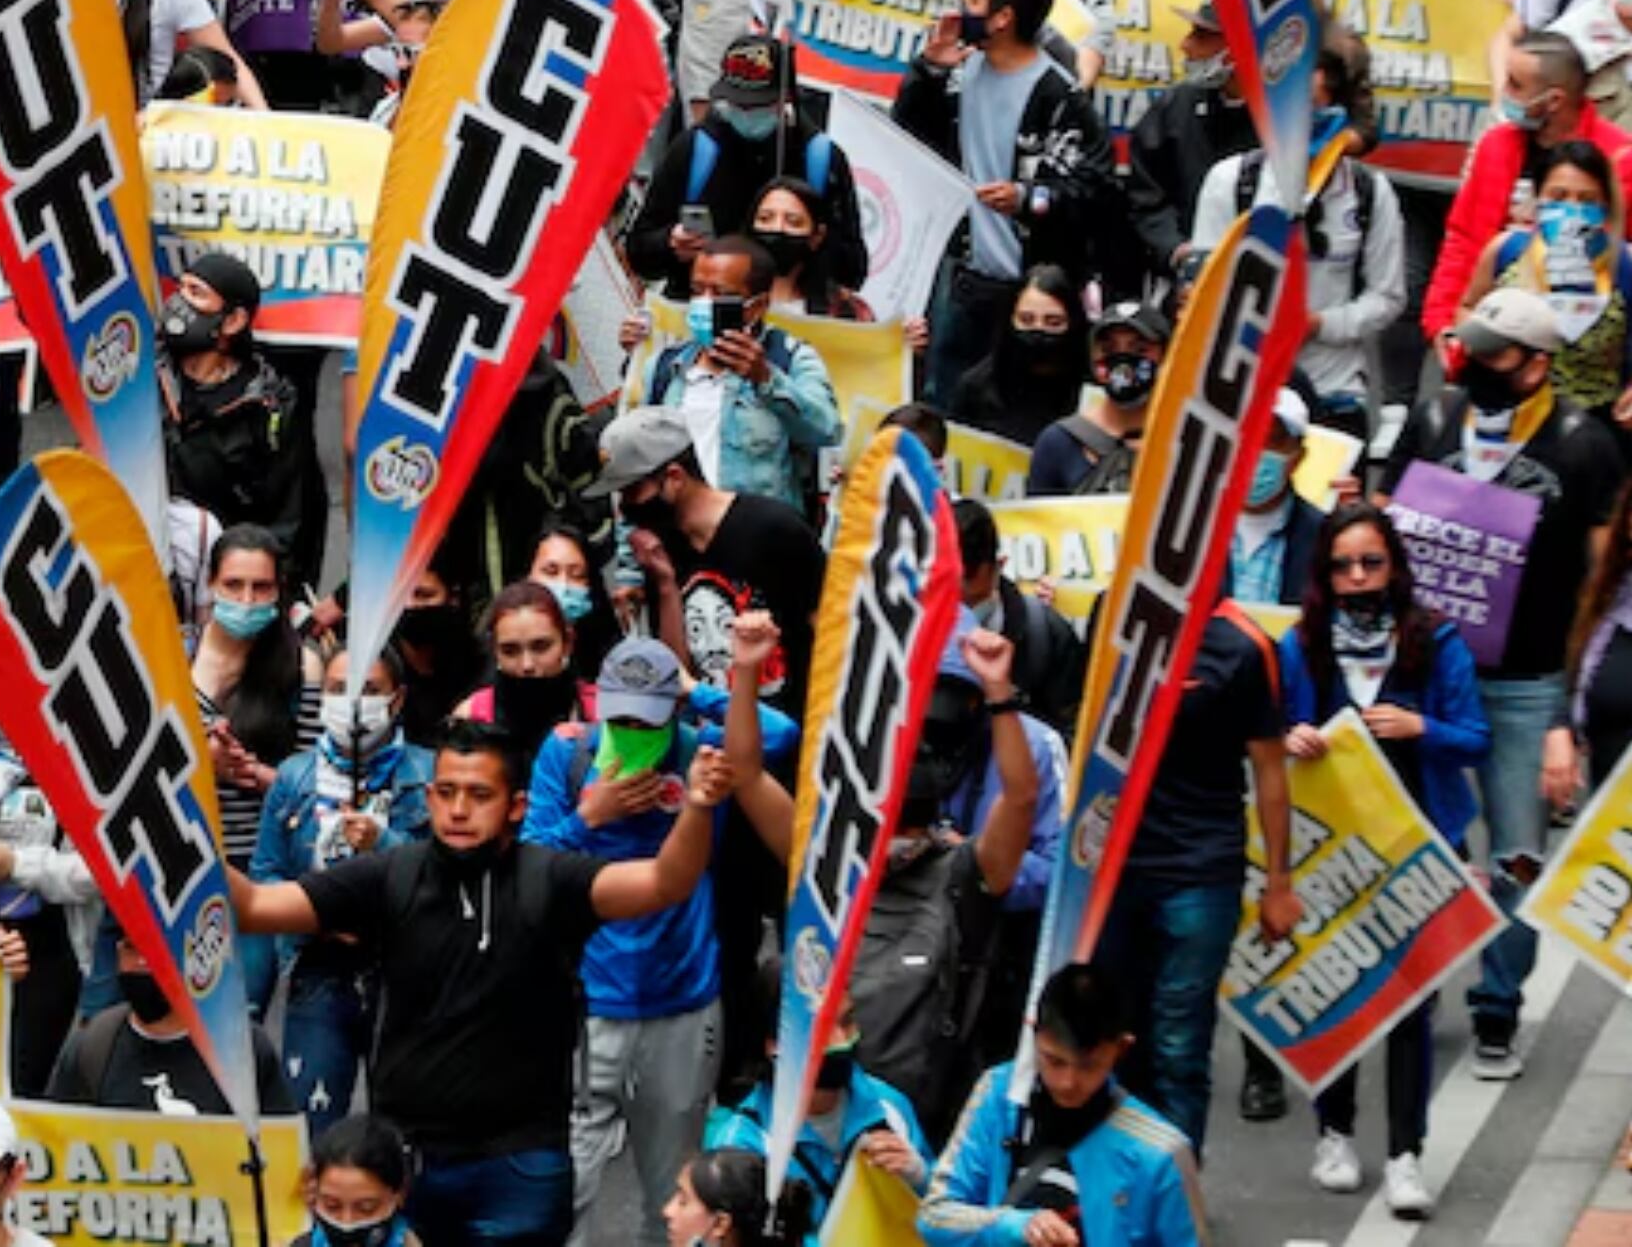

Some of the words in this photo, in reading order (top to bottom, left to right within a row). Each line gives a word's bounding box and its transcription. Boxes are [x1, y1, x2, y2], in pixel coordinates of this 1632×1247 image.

[155, 131, 216, 171] NO
[229, 140, 258, 174] A
[269, 141, 326, 182] LA
[154, 184, 354, 236] REFORMA
[1103, 244, 1280, 762] CUT
[1062, 534, 1092, 585] A
[1445, 570, 1488, 599] LA
[0, 494, 212, 914] CUT
[1258, 841, 1465, 1038] TRIBUTARIA
[66, 1142, 103, 1183] A
[121, 1141, 189, 1185] LA
